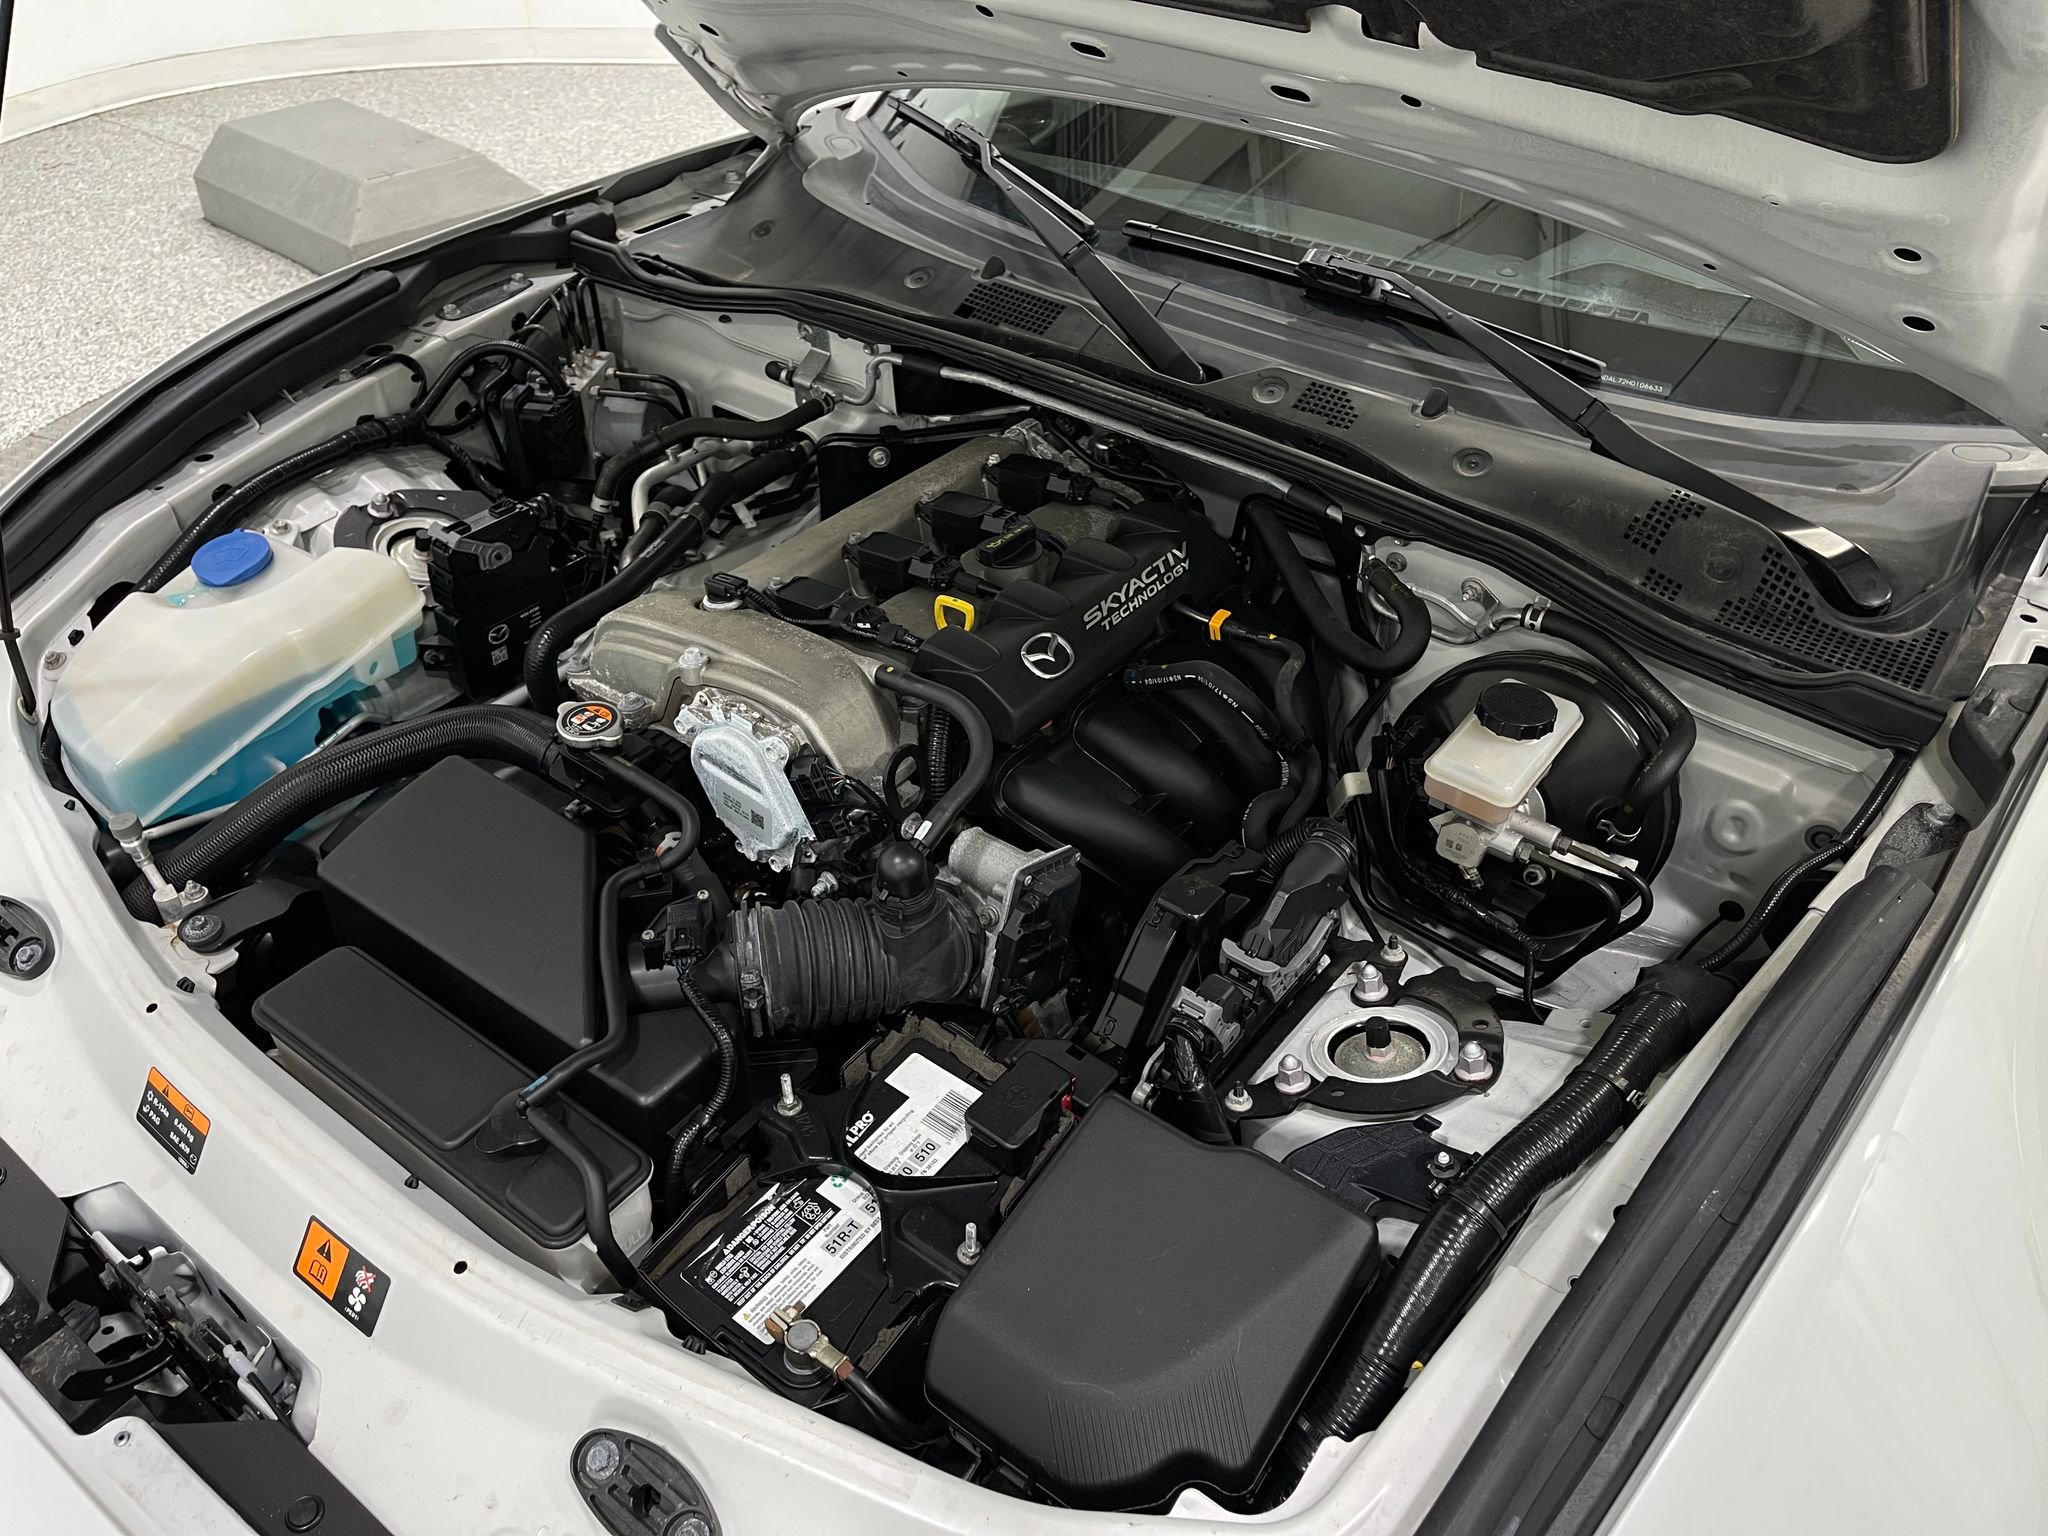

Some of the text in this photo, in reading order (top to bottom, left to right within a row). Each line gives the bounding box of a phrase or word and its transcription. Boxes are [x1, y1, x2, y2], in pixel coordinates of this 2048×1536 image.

[1083, 540, 1187, 630] SKYACTIV
[1101, 558, 1189, 631] TECHNOLOGY
[148, 1109, 161, 1126] PAG
[845, 1111, 875, 1148] LPRO
[915, 1142, 936, 1162] 510
[825, 1220, 859, 1254] 51R-T
